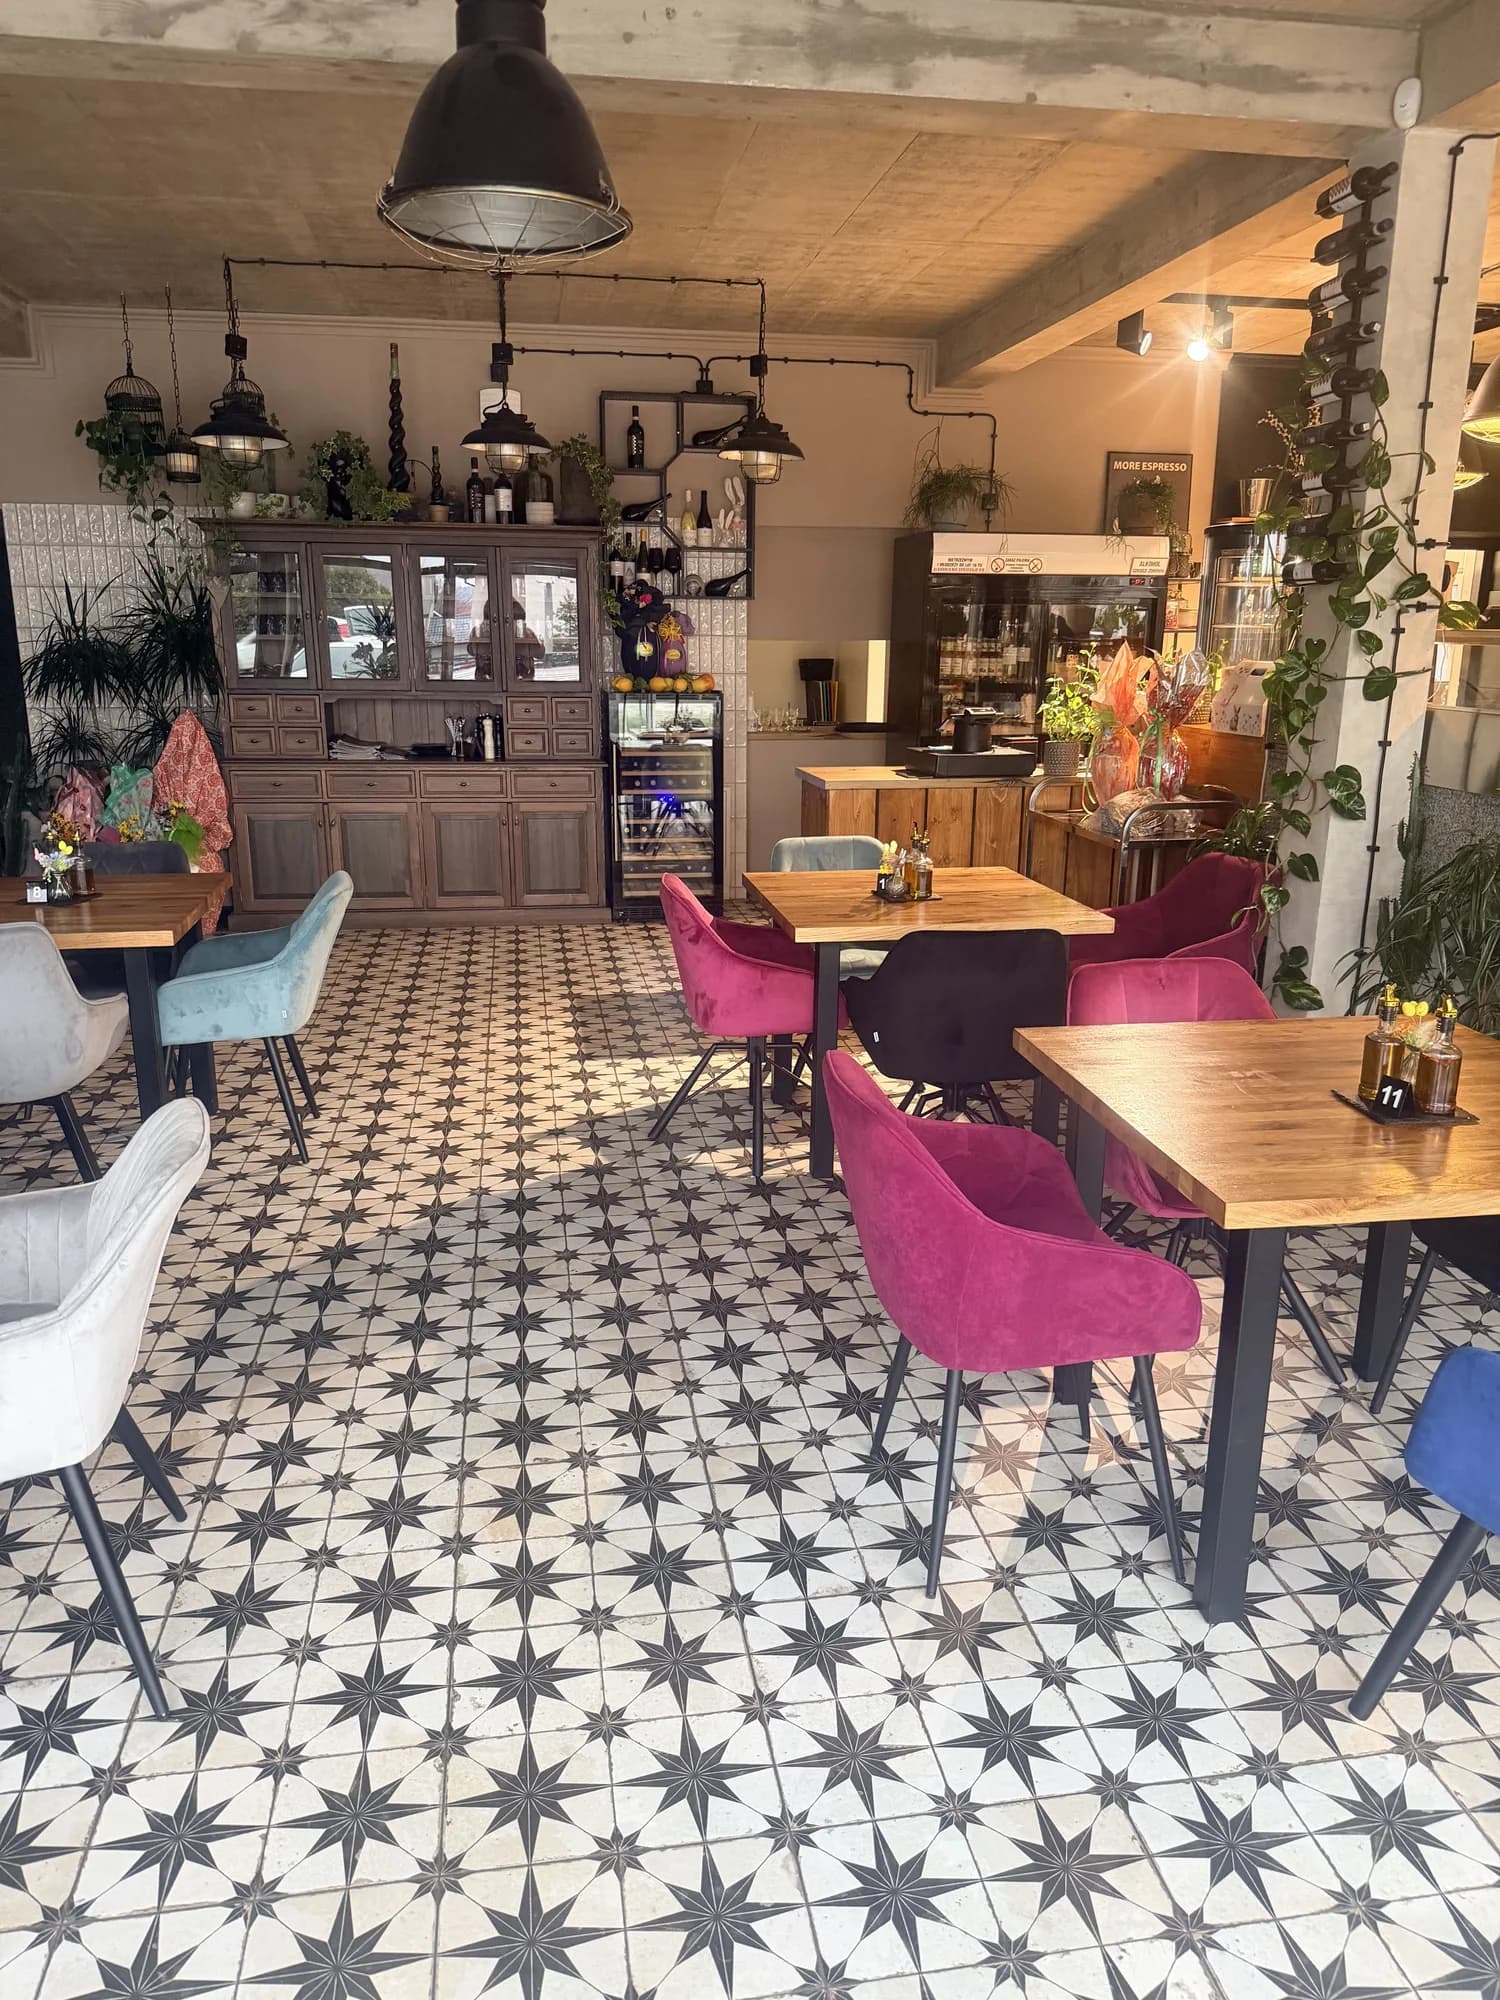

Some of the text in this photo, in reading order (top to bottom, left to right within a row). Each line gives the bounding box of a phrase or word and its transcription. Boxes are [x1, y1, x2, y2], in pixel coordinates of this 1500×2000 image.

[1113, 461, 1187, 472] MORE ESPRESSO
[33, 886, 42, 898] 8
[1381, 1085, 1403, 1109] 11
